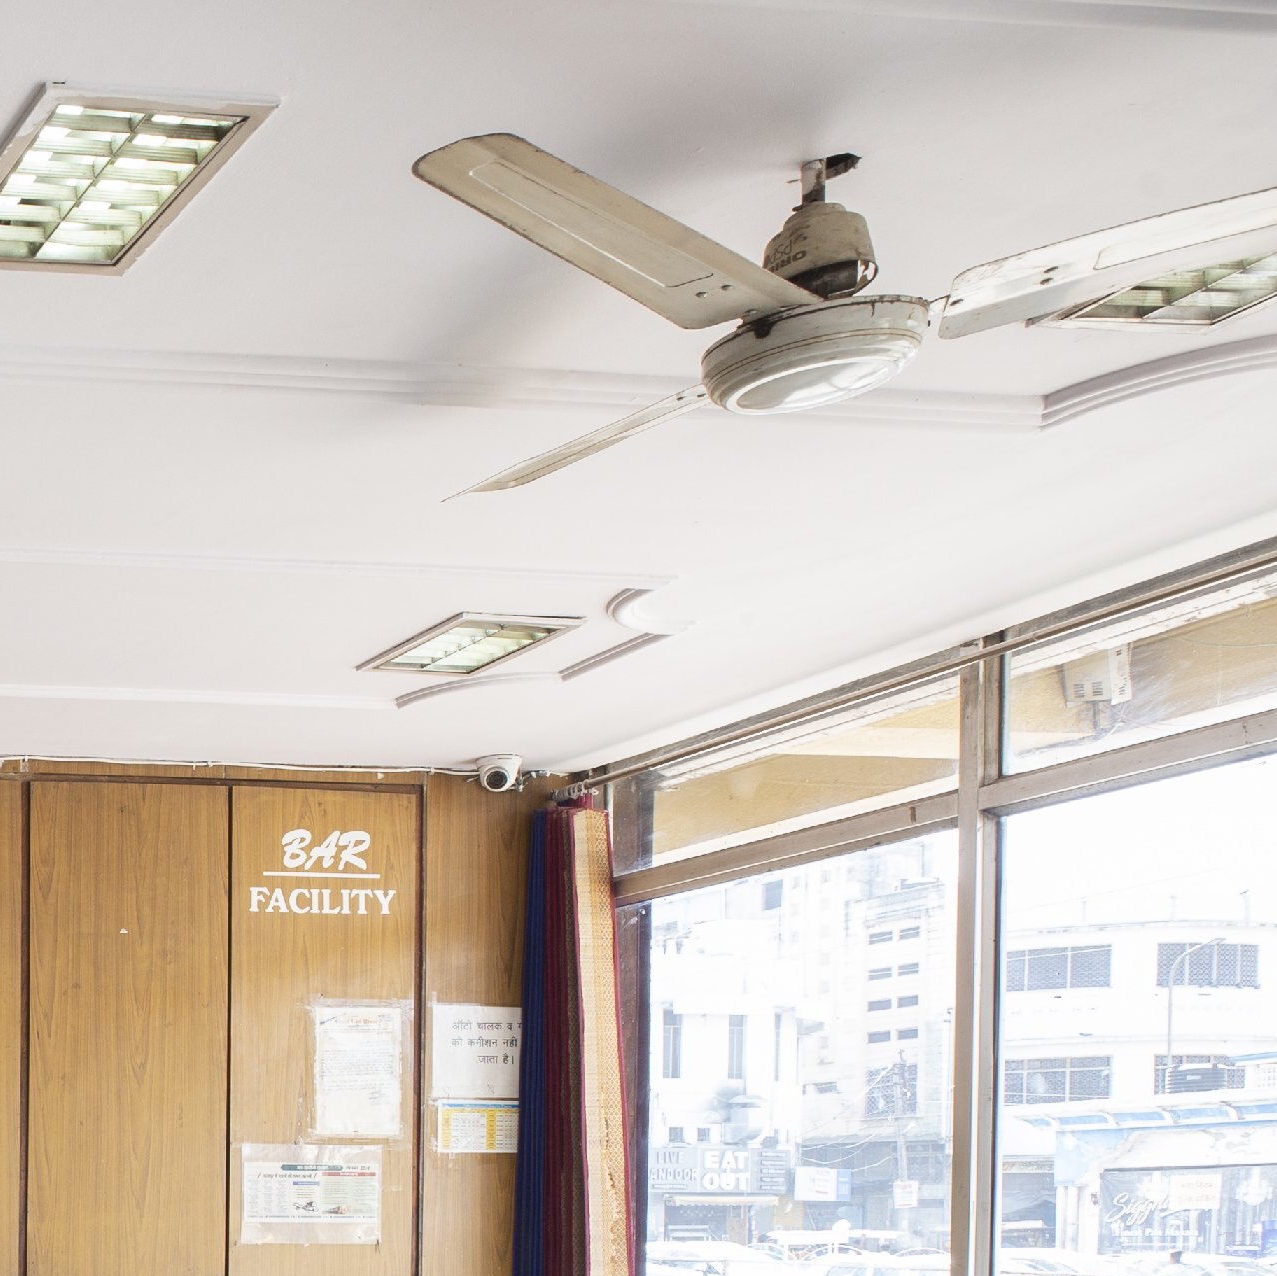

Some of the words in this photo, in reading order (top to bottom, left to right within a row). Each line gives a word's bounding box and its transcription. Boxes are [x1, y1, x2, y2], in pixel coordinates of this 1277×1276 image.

[282, 828, 371, 871] BAR
[249, 886, 396, 915] FACILITY
[477, 1055, 498, 1064] जाता
[704, 1150, 749, 1169] EAT
[649, 1168, 697, 1181] ANDOOR
[702, 1171, 749, 1190] OUT
